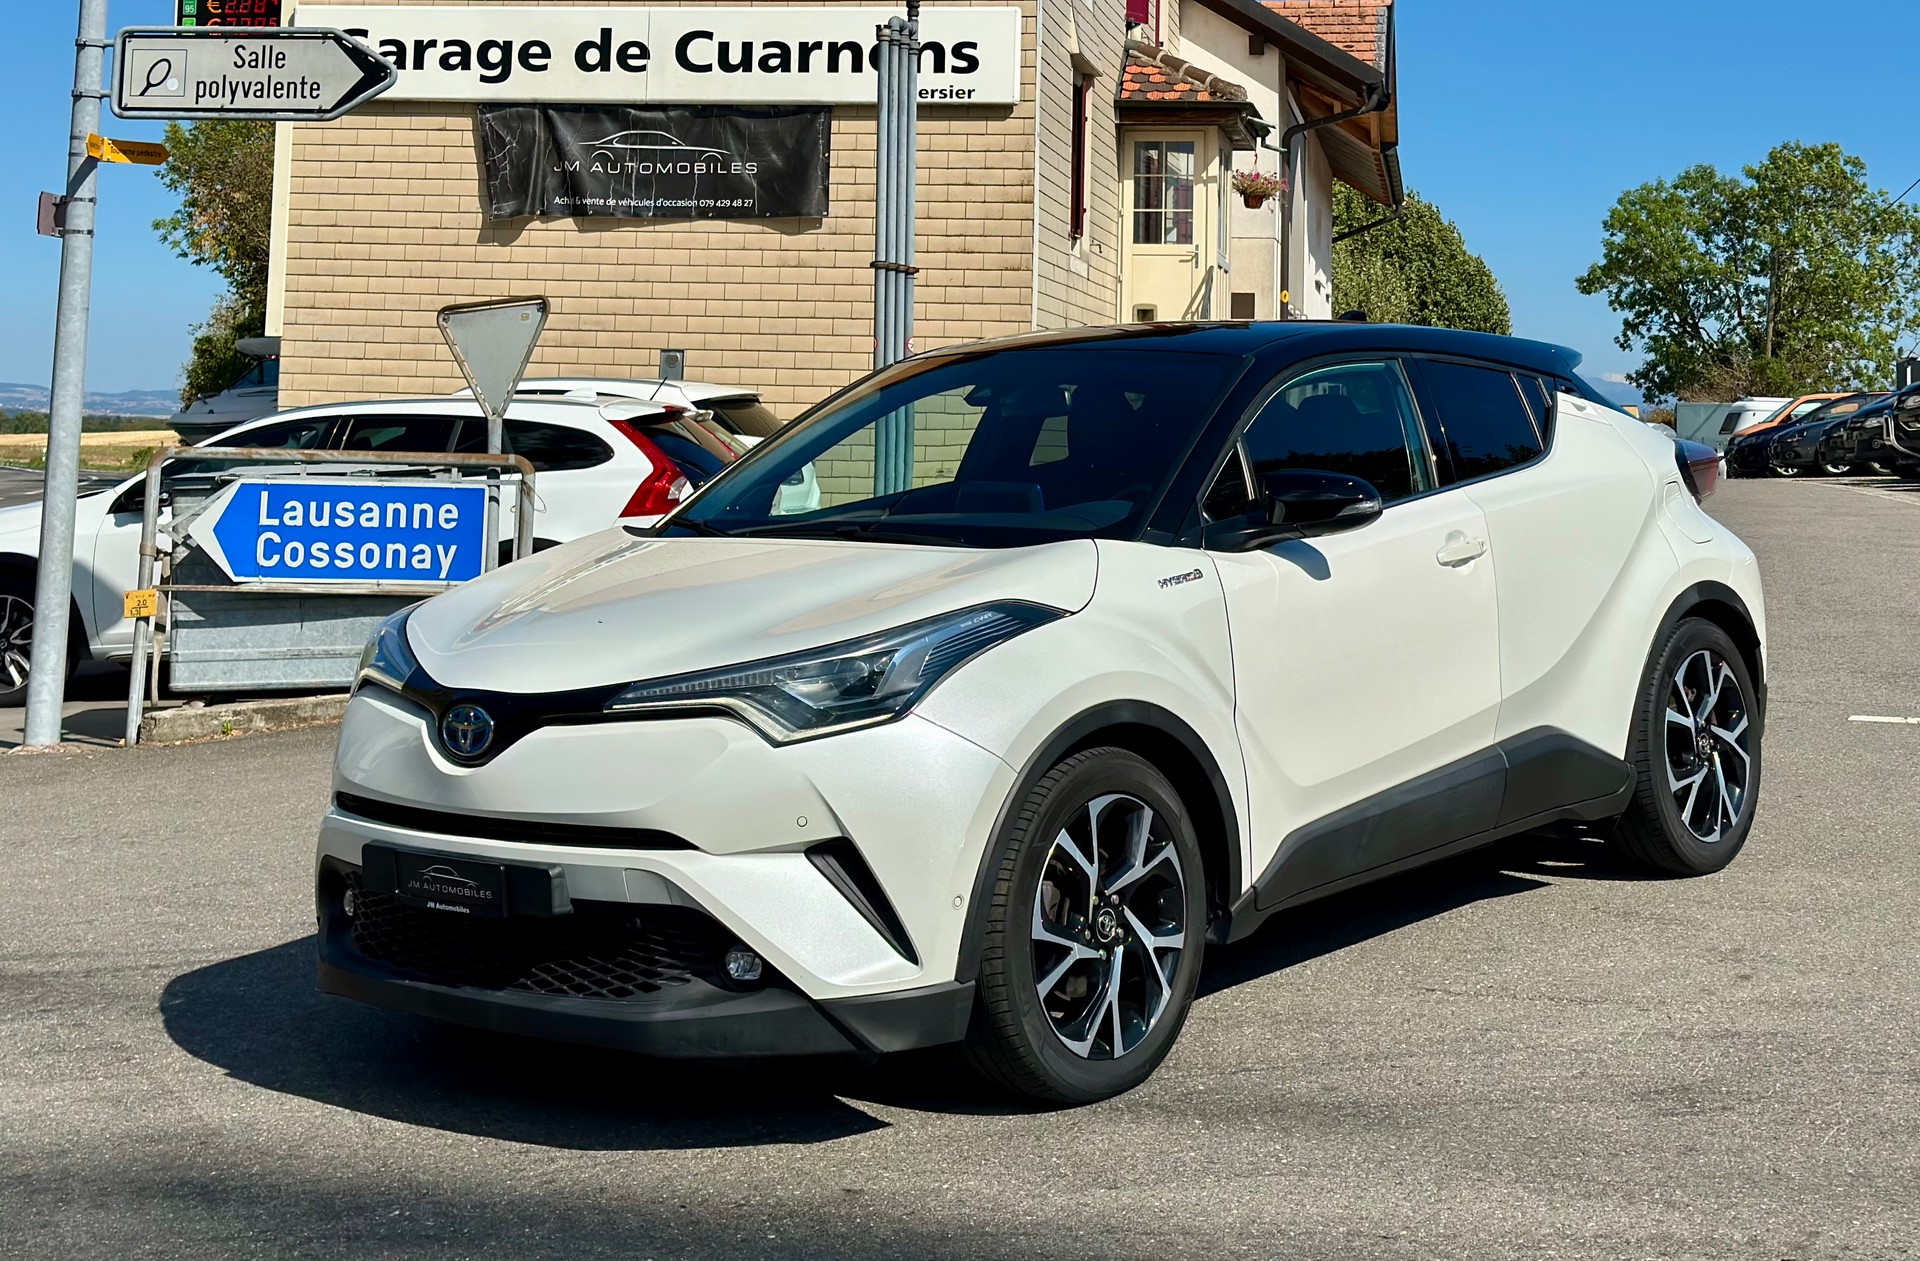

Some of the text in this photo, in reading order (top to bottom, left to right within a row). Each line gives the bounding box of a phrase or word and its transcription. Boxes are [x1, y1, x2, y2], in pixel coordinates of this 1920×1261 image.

[233, 44, 286, 69] Salle
[573, 28, 650, 73] de
[674, 30, 980, 74] Cuarnns
[195, 74, 321, 105] polyvalente
[918, 84, 976, 99] ersier
[553, 160, 758, 174] JM AUTOMOBILES
[582, 197, 605, 206] vente
[605, 197, 617, 206] de
[617, 197, 655, 207] véhicules
[655, 198, 698, 207] d'occasion
[699, 199, 715, 208] 079
[715, 199, 731, 208] 429
[731, 199, 743, 208] 48
[743, 199, 754, 208] 27
[259, 490, 460, 530] Lausanne
[256, 531, 458, 579] Cossonay
[408, 880, 493, 899] JM AUTOMOBILES
[436, 902, 470, 913] Automobiles
